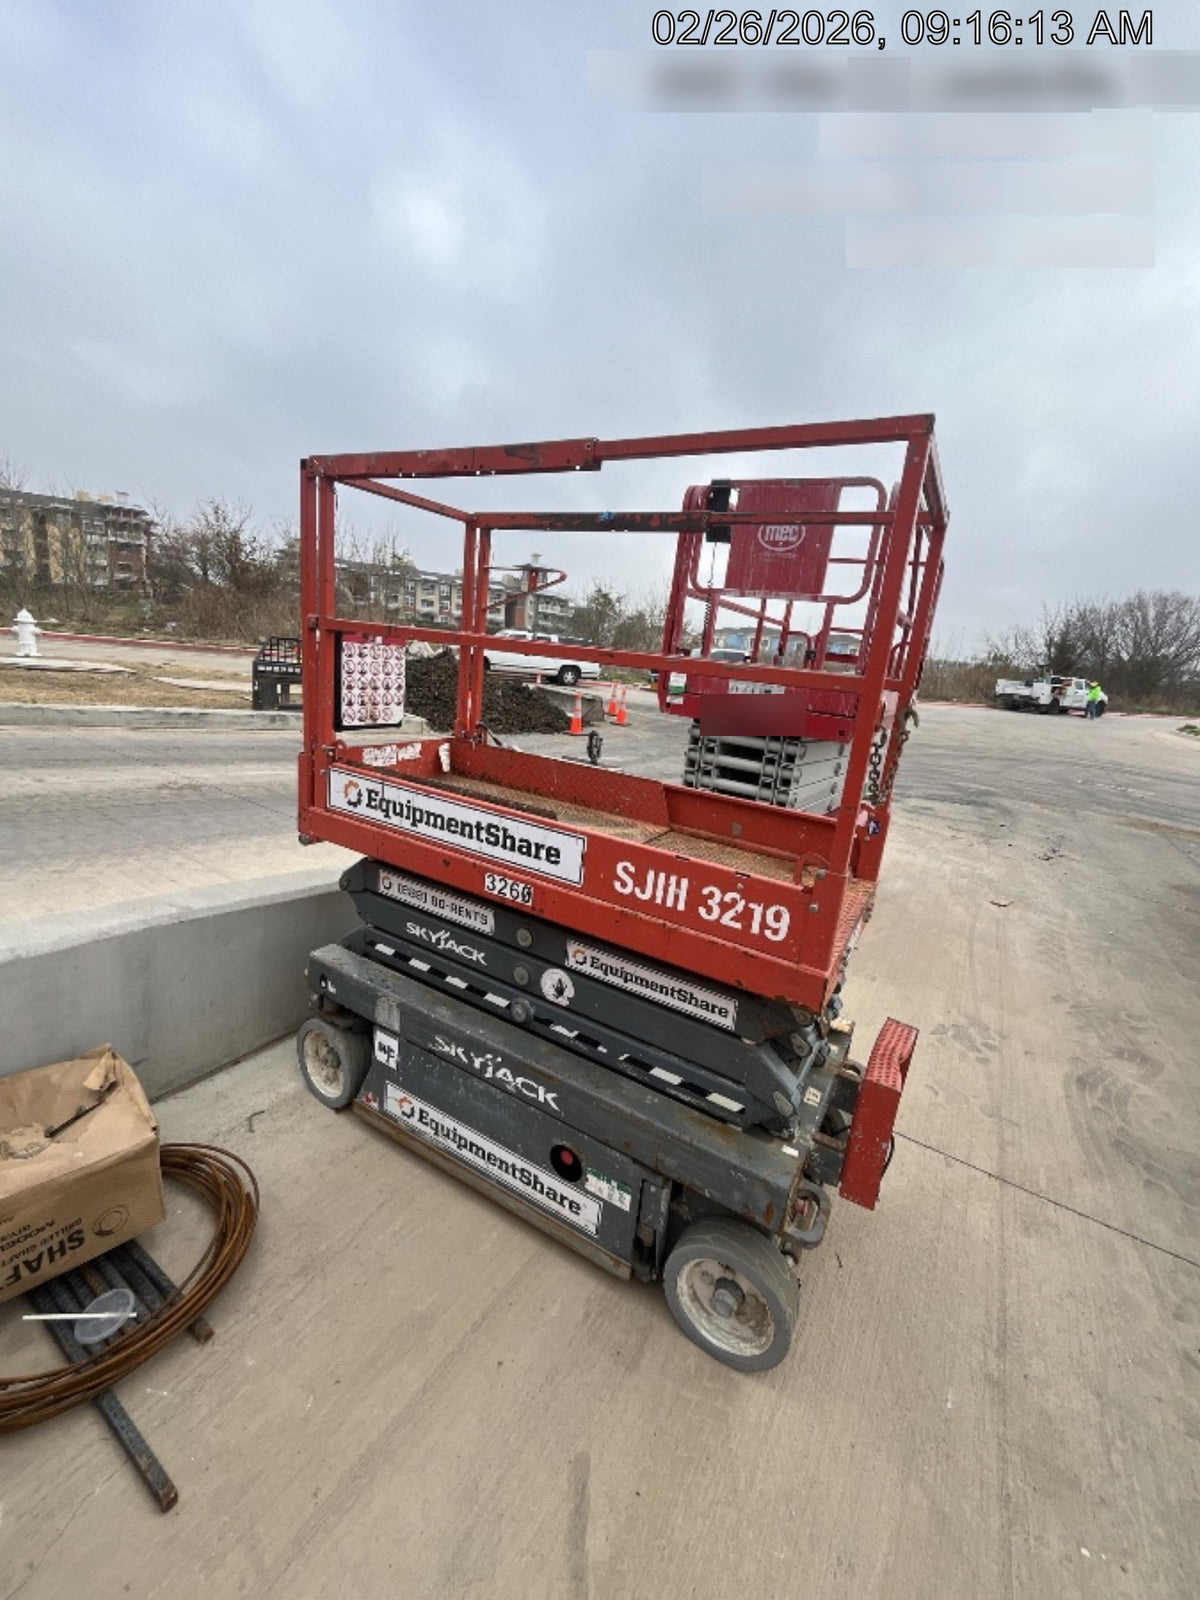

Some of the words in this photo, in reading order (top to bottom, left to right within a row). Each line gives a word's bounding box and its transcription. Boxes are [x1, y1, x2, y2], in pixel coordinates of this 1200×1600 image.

[365, 787, 561, 865] EquipmentShare
[486, 874, 532, 903] 3260
[613, 861, 689, 911] SJIH
[698, 886, 790, 941] 3219
[405, 922, 487, 966] SKYJACK
[590, 954, 728, 1018] EquipmentShare
[417, 1106, 581, 1217] EquipmentShare
[0, 1229, 85, 1292] SHAF
